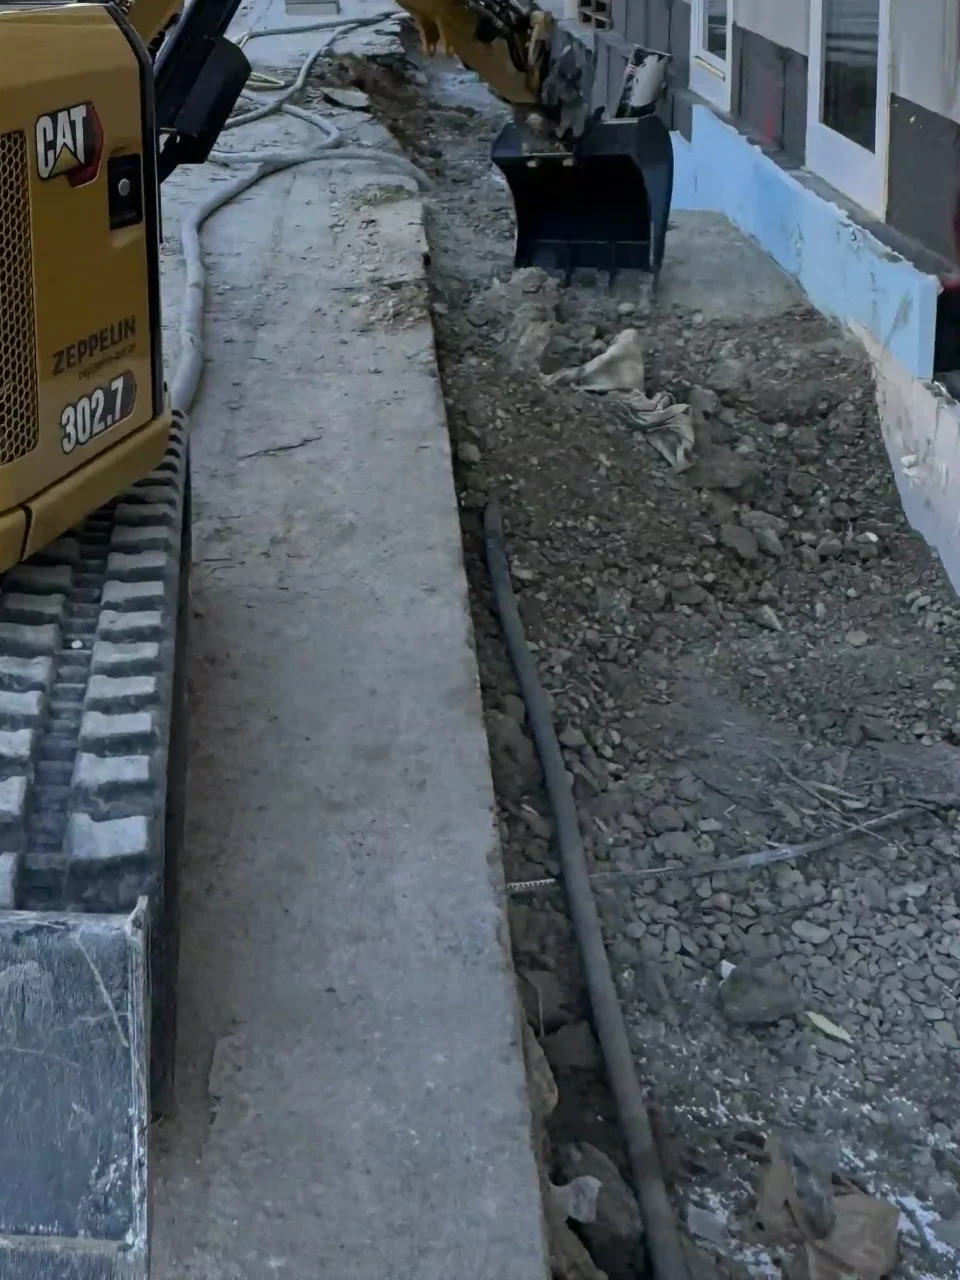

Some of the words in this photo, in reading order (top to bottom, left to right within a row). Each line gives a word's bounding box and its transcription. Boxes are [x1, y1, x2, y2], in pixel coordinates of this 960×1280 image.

[36, 104, 87, 179] CAT
[52, 315, 137, 376] ZEPPELIN
[61, 375, 125, 453] 302.7
